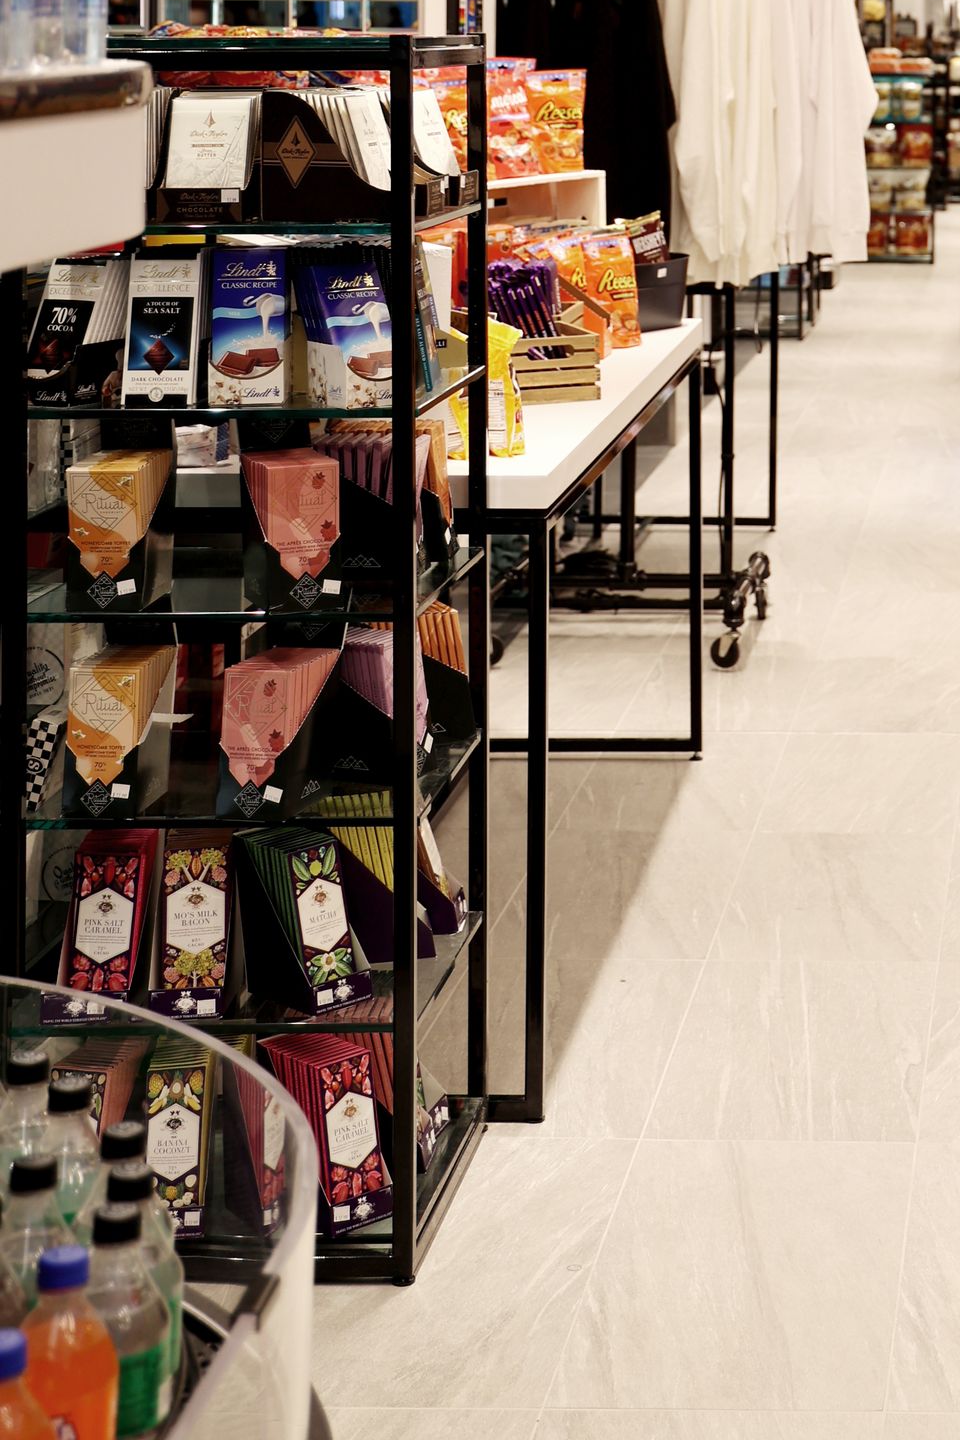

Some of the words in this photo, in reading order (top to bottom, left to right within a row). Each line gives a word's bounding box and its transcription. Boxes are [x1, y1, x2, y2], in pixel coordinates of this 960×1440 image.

[138, 264, 182, 280] Lindt
[222, 262, 266, 278] Lindt
[54, 268, 90, 284] Lindt
[221, 282, 252, 290] CLASSIC
[252, 281, 277, 289] RECIPE
[326, 276, 363, 289] Lindt
[327, 291, 354, 301] CLASSIC
[355, 291, 379, 299] RECIPE
[51, 307, 78, 325] 70%
[143, 307, 159, 315] SEA
[160, 307, 182, 315] SALT
[46, 324, 74, 332] COCOA
[35, 390, 61, 402] Lindt
[241, 388, 271, 398] Lindt
[377, 389, 392, 399] Lin
[81, 492, 126, 515] Ritual
[82, 692, 125, 715] Ritual
[174, 912, 196, 921] MO'S
[197, 910, 218, 918] MILK
[309, 911, 338, 925] MATCHA
[84, 919, 103, 927] PINK
[103, 919, 125, 927] SALT
[181, 918, 211, 927] BACON
[84, 926, 123, 934] CARAMEL
[334, 1126, 350, 1136] PINK
[351, 1120, 369, 1131] SALT
[335, 1128, 369, 1144] CARAMEL
[157, 1139, 189, 1148] BANANA
[153, 1146, 191, 1155] COCONUT
